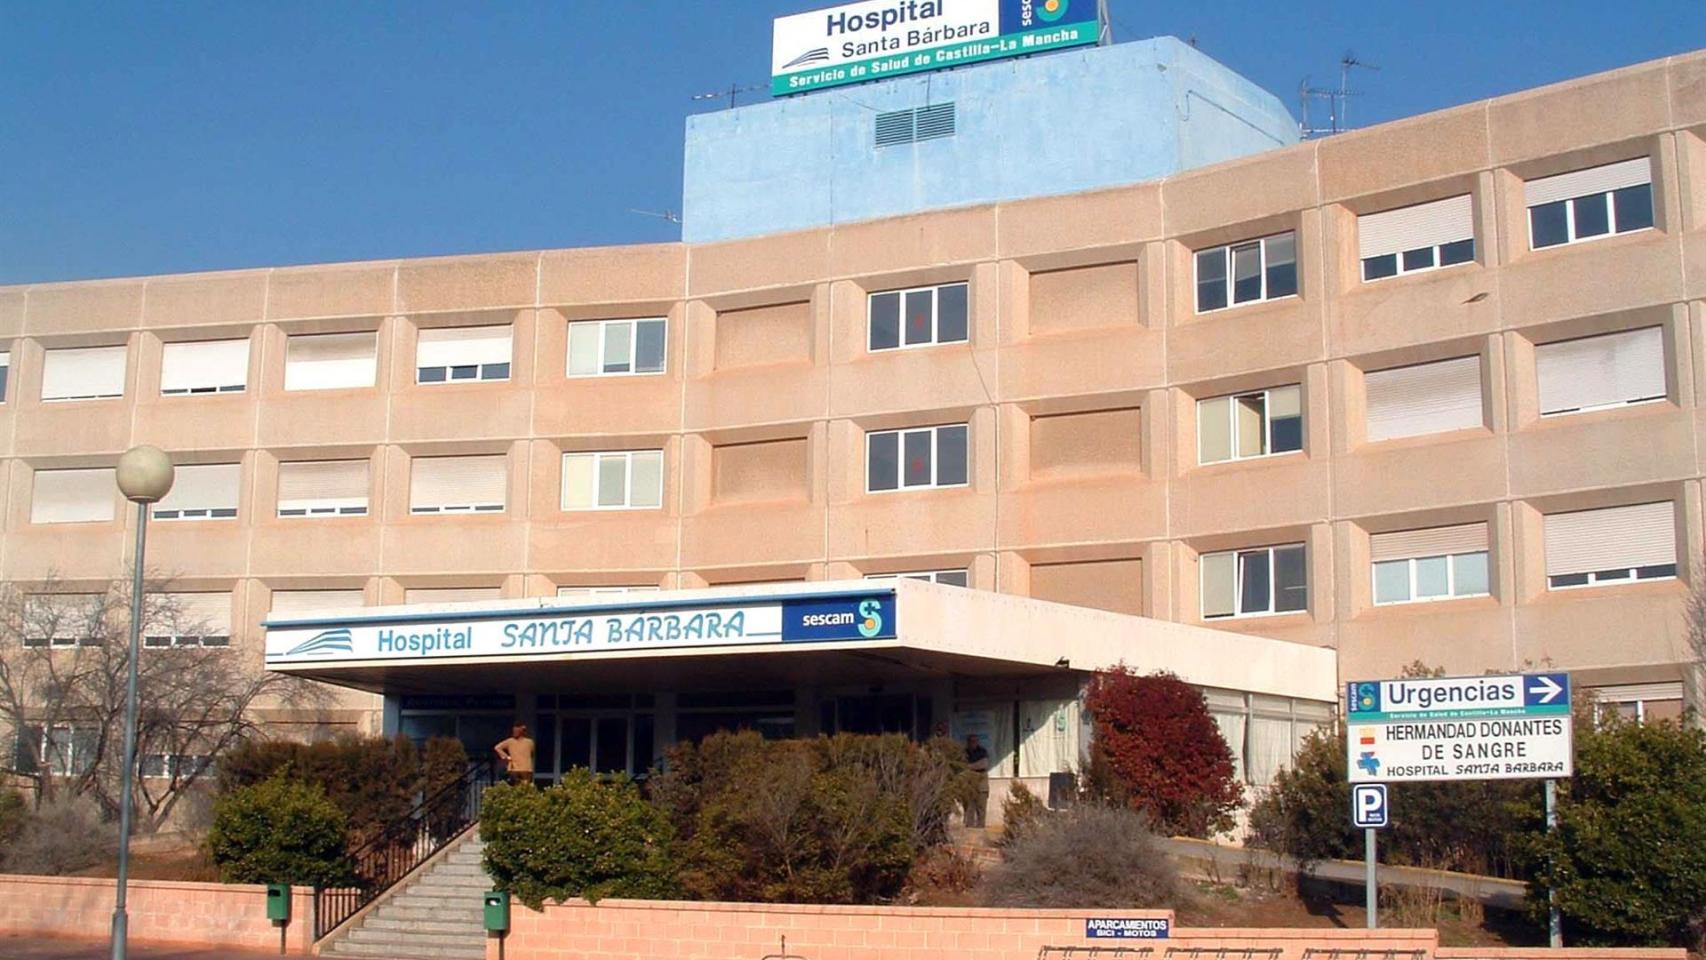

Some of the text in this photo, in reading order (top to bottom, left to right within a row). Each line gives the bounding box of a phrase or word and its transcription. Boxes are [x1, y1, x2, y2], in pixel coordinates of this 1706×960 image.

[827, 0, 943, 36] Hospital
[842, 21, 990, 58] Santa Bárbara
[789, 69, 845, 88] Servicio
[851, 65, 866, 77] de
[871, 56, 909, 74] Salud
[914, 54, 930, 66] de
[1022, 28, 1079, 48] Mancha
[803, 612, 854, 626] sescam
[378, 627, 472, 656] Hospital
[501, 618, 593, 648] SANTA
[1389, 680, 1515, 708] Urgencias
[1386, 719, 1562, 741] HERMANDAD DONANTES
[1422, 742, 1526, 760] DE SANGRE
[1387, 765, 1448, 777] HOSPITAL
[1505, 762, 1563, 773] BARBARA
[1358, 789, 1382, 822] P
[1088, 919, 1167, 929] APARCAMIENTOS
[1123, 929, 1157, 937] MOTOS
